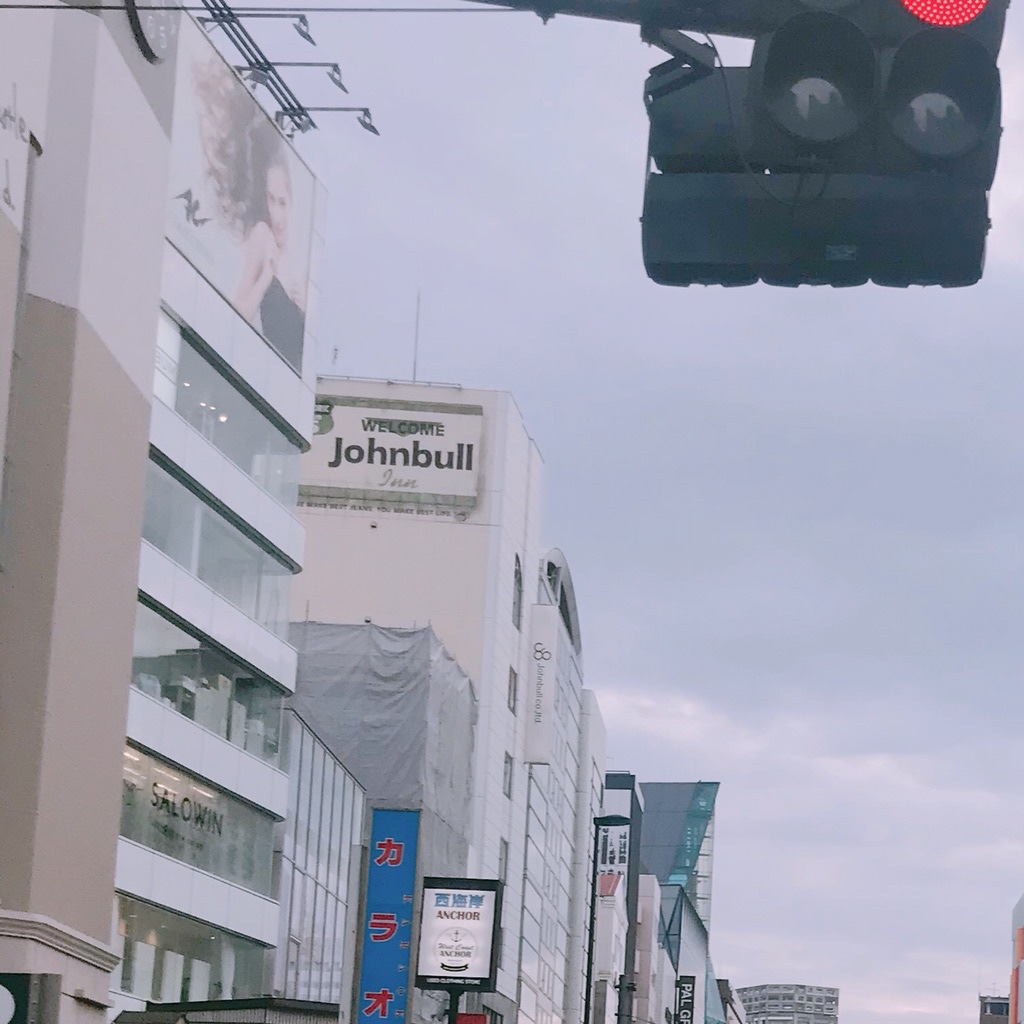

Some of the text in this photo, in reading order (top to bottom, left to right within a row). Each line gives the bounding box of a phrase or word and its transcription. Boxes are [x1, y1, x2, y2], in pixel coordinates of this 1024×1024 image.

[361, 417, 445, 437] WELCOME
[328, 437, 473, 471] Johnbull
[151, 782, 224, 837] SALOWIN
[434, 892, 485, 909] 西海岸
[435, 910, 481, 921] ANCHOR
[439, 951, 472, 959] ANCHOR
[680, 983, 693, 1007] PAL
